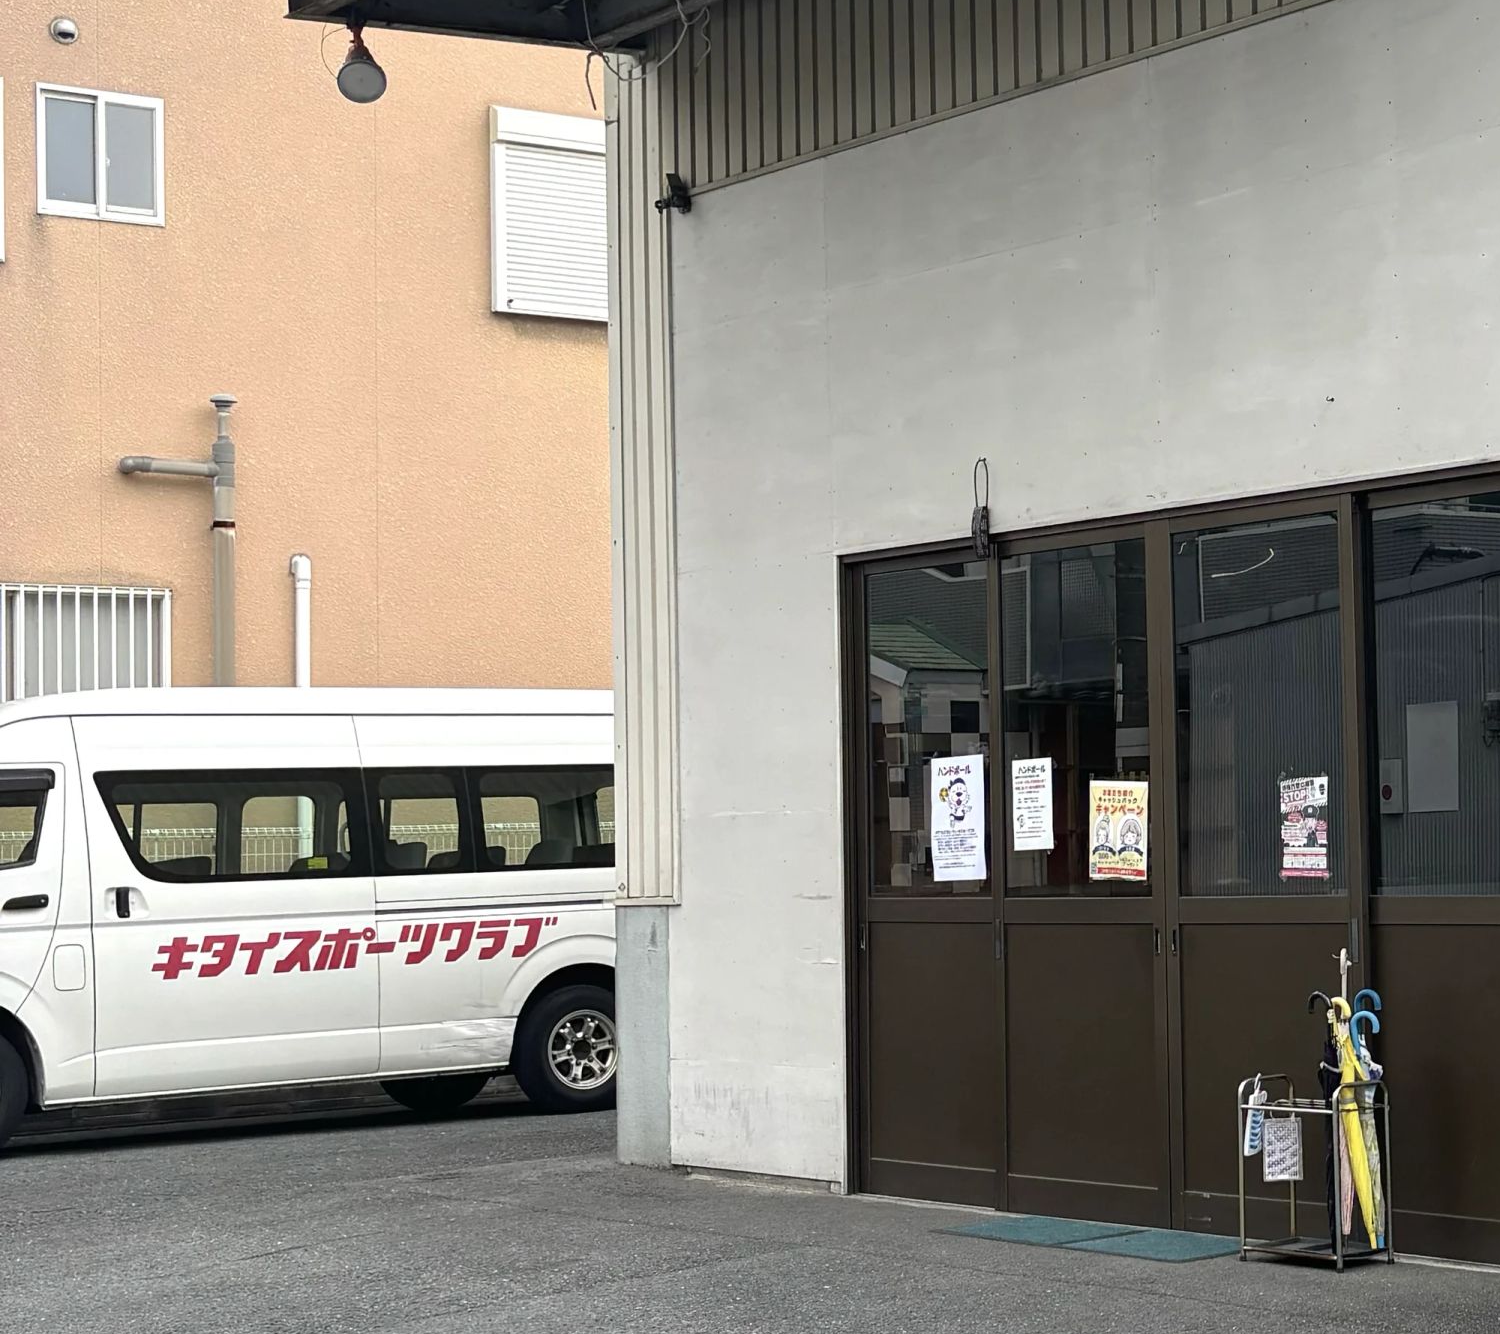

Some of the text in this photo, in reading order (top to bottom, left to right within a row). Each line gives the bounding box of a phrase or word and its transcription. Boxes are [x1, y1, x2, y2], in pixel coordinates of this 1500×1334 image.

[151, 917, 558, 979] キタイスポーツクラブ
